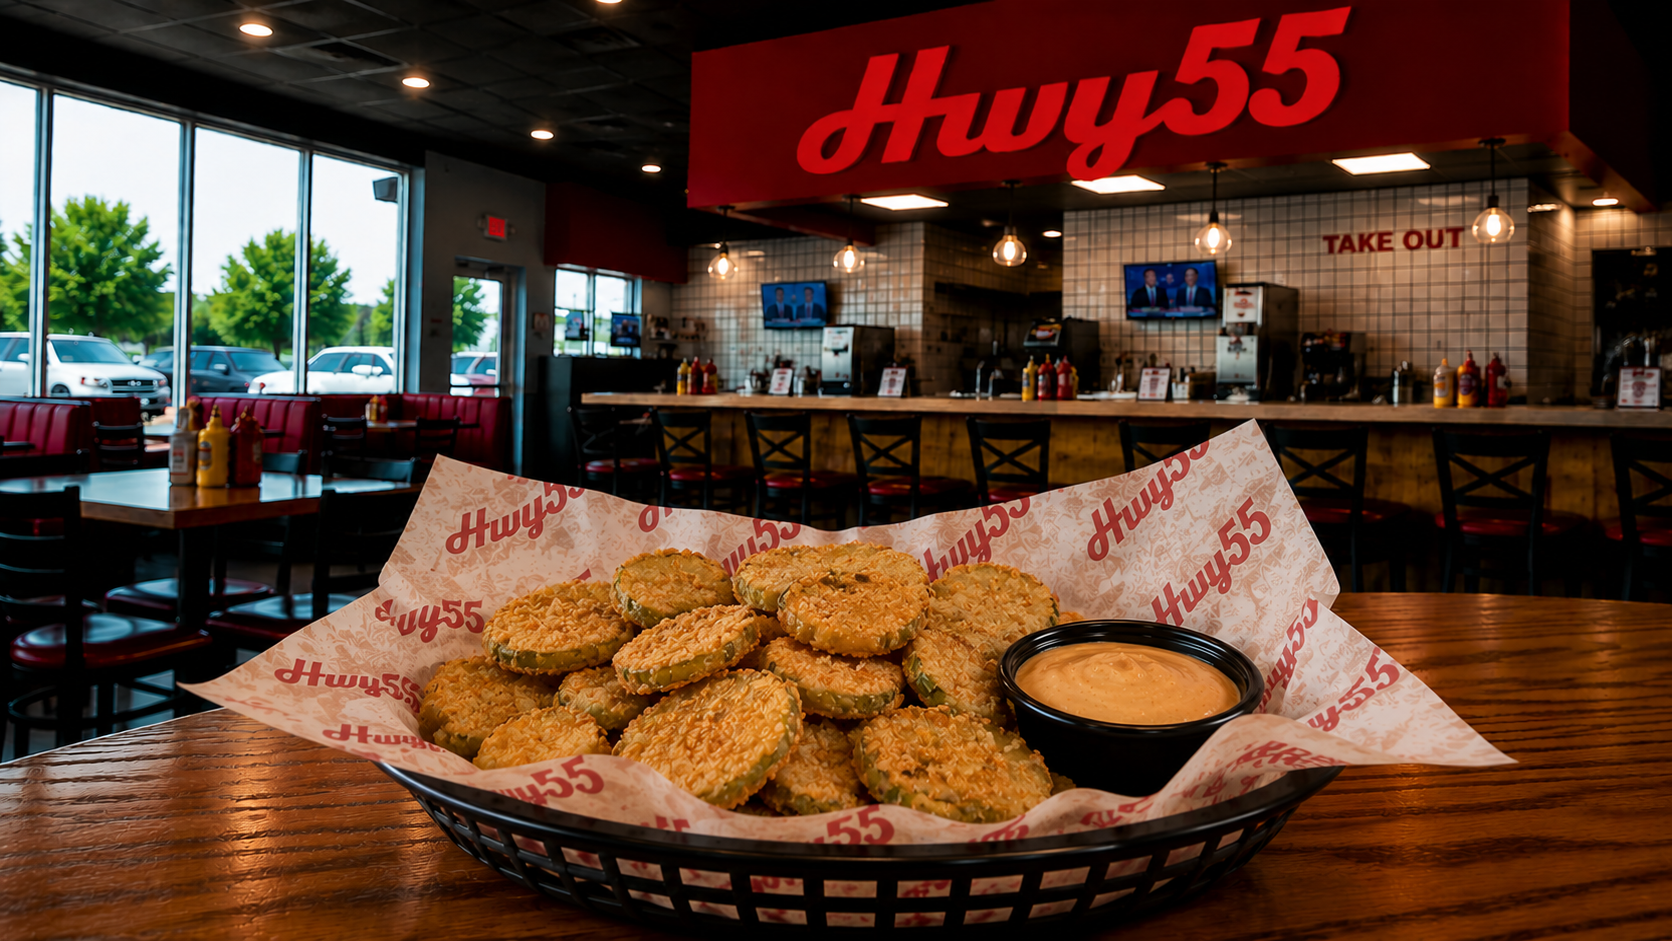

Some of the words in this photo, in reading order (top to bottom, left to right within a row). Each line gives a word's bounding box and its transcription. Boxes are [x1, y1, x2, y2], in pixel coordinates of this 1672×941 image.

[797, 6, 1351, 181] Hwy55
[1322, 231, 1394, 254] TAKE
[1402, 226, 1465, 251] OUT
